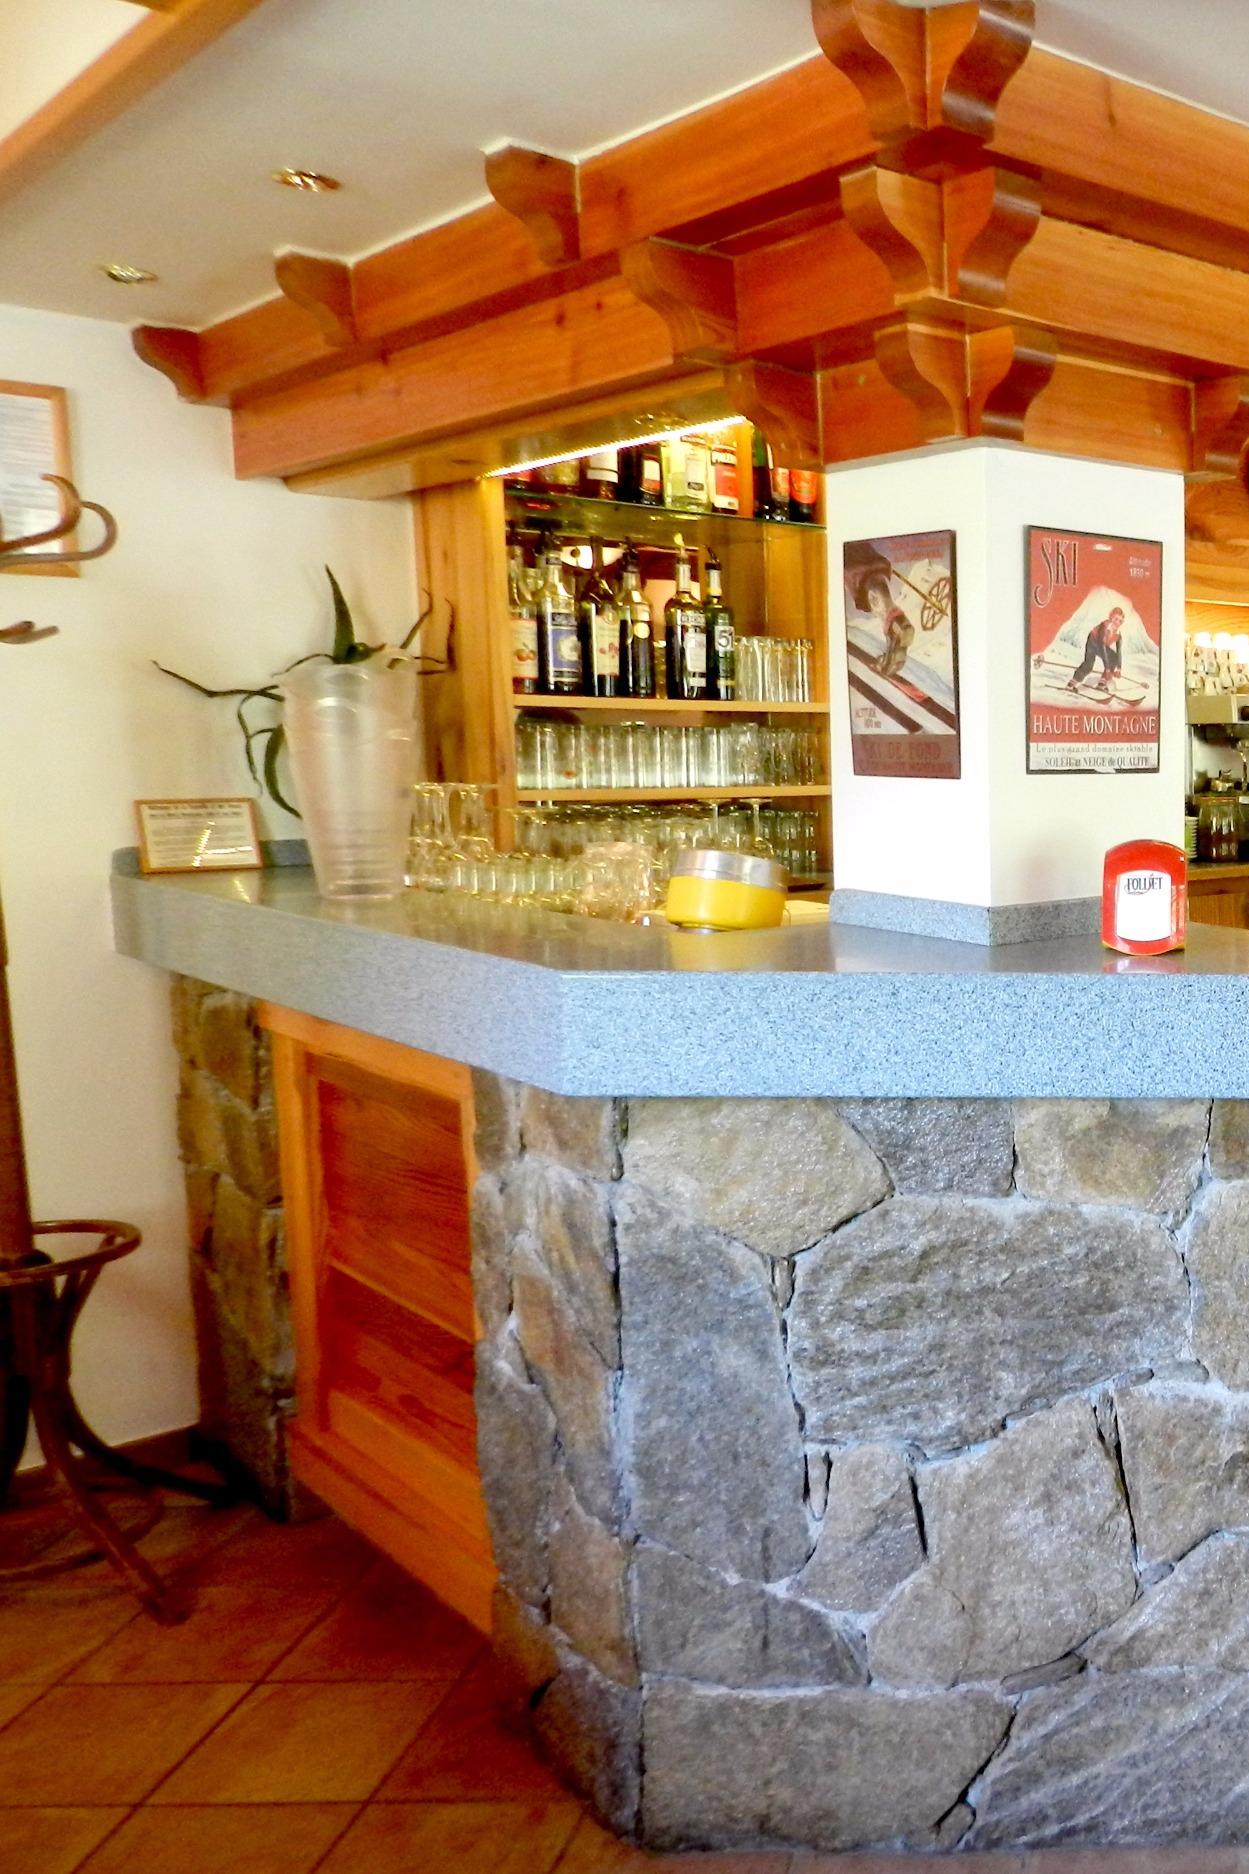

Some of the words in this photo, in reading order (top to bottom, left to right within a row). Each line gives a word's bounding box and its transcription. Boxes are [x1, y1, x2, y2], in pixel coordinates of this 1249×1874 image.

[1033, 538, 1079, 608] SKI
[718, 629, 735, 648] 51
[1033, 715, 1080, 735] HAUTE
[1082, 715, 1157, 735] MONTAGNE
[1082, 756, 1106, 768] NEIGE
